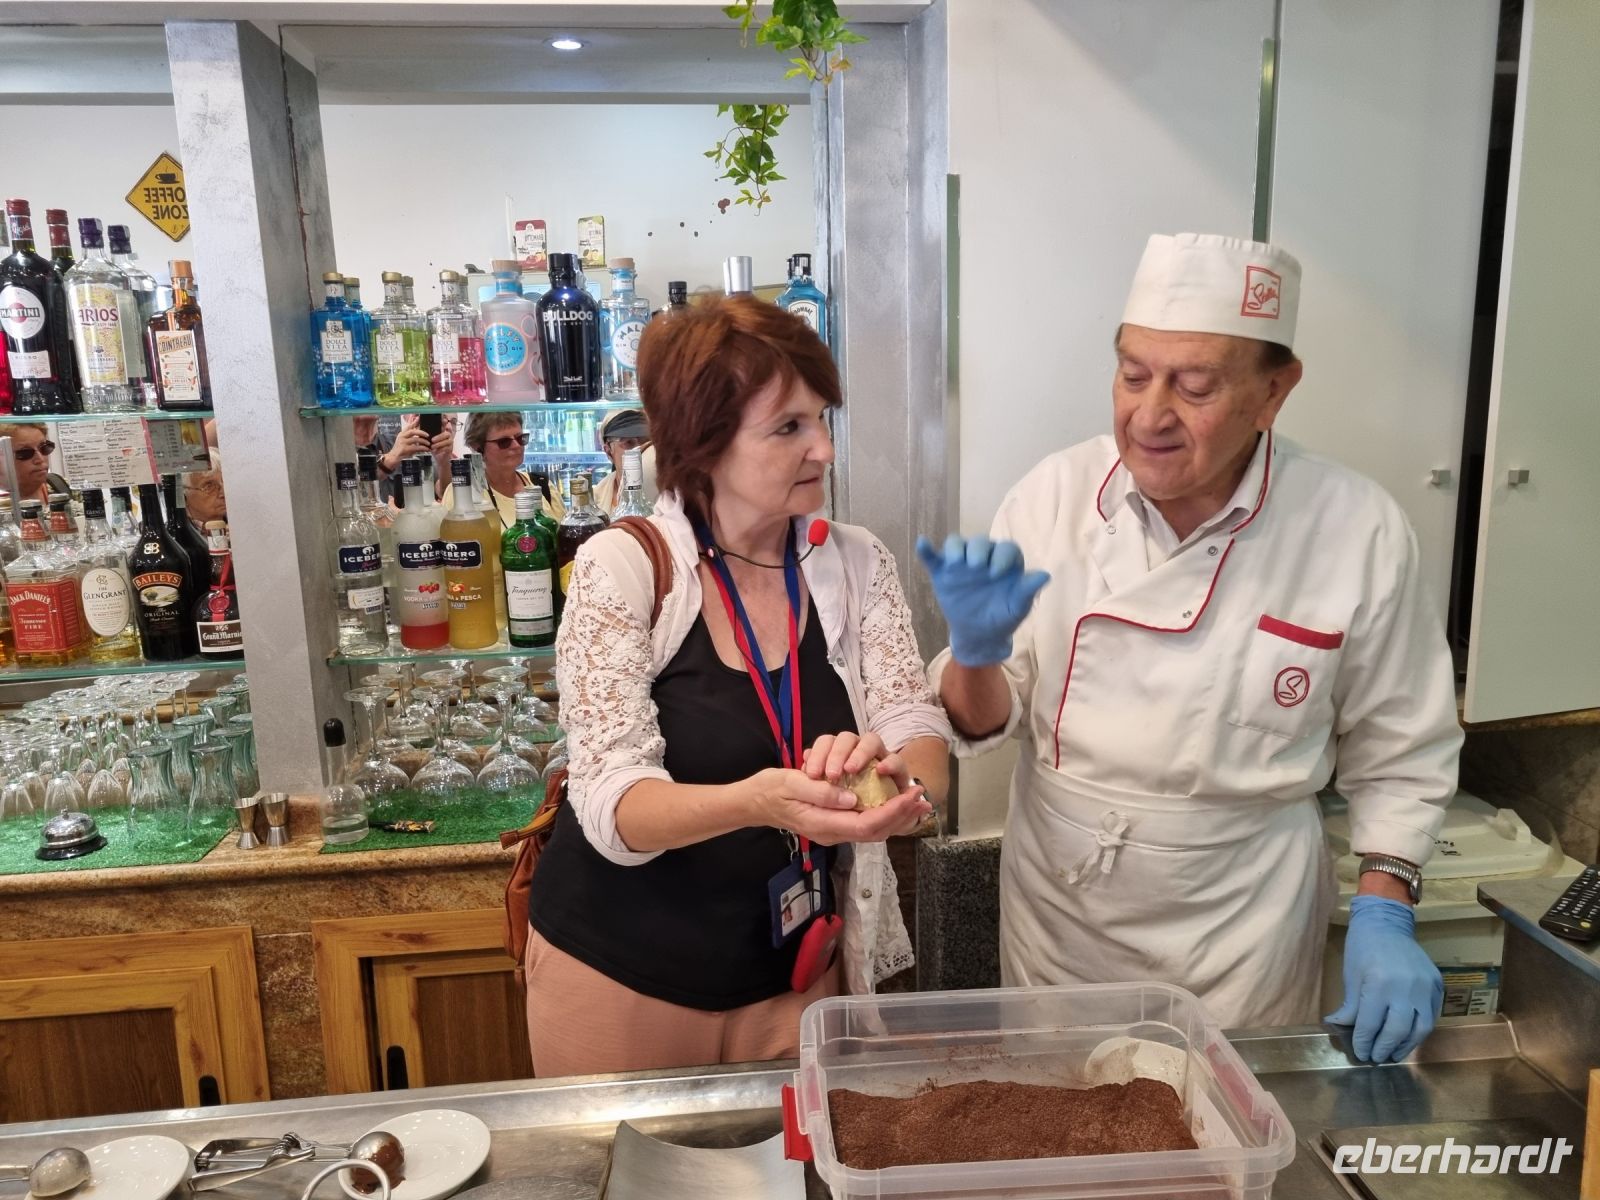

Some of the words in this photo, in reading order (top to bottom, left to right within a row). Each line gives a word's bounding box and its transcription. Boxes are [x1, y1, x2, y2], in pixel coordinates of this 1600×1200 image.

[0, 308, 40, 318] MARTINI
[79, 308, 119, 322] ARIOS
[542, 310, 593, 322] BULLDOG
[619, 324, 645, 340] MAL
[135, 573, 180, 587] BAILEYS
[10, 593, 27, 606] JACK
[24, 590, 51, 605] DANIEL'S
[144, 610, 180, 618] ORIGINAL
